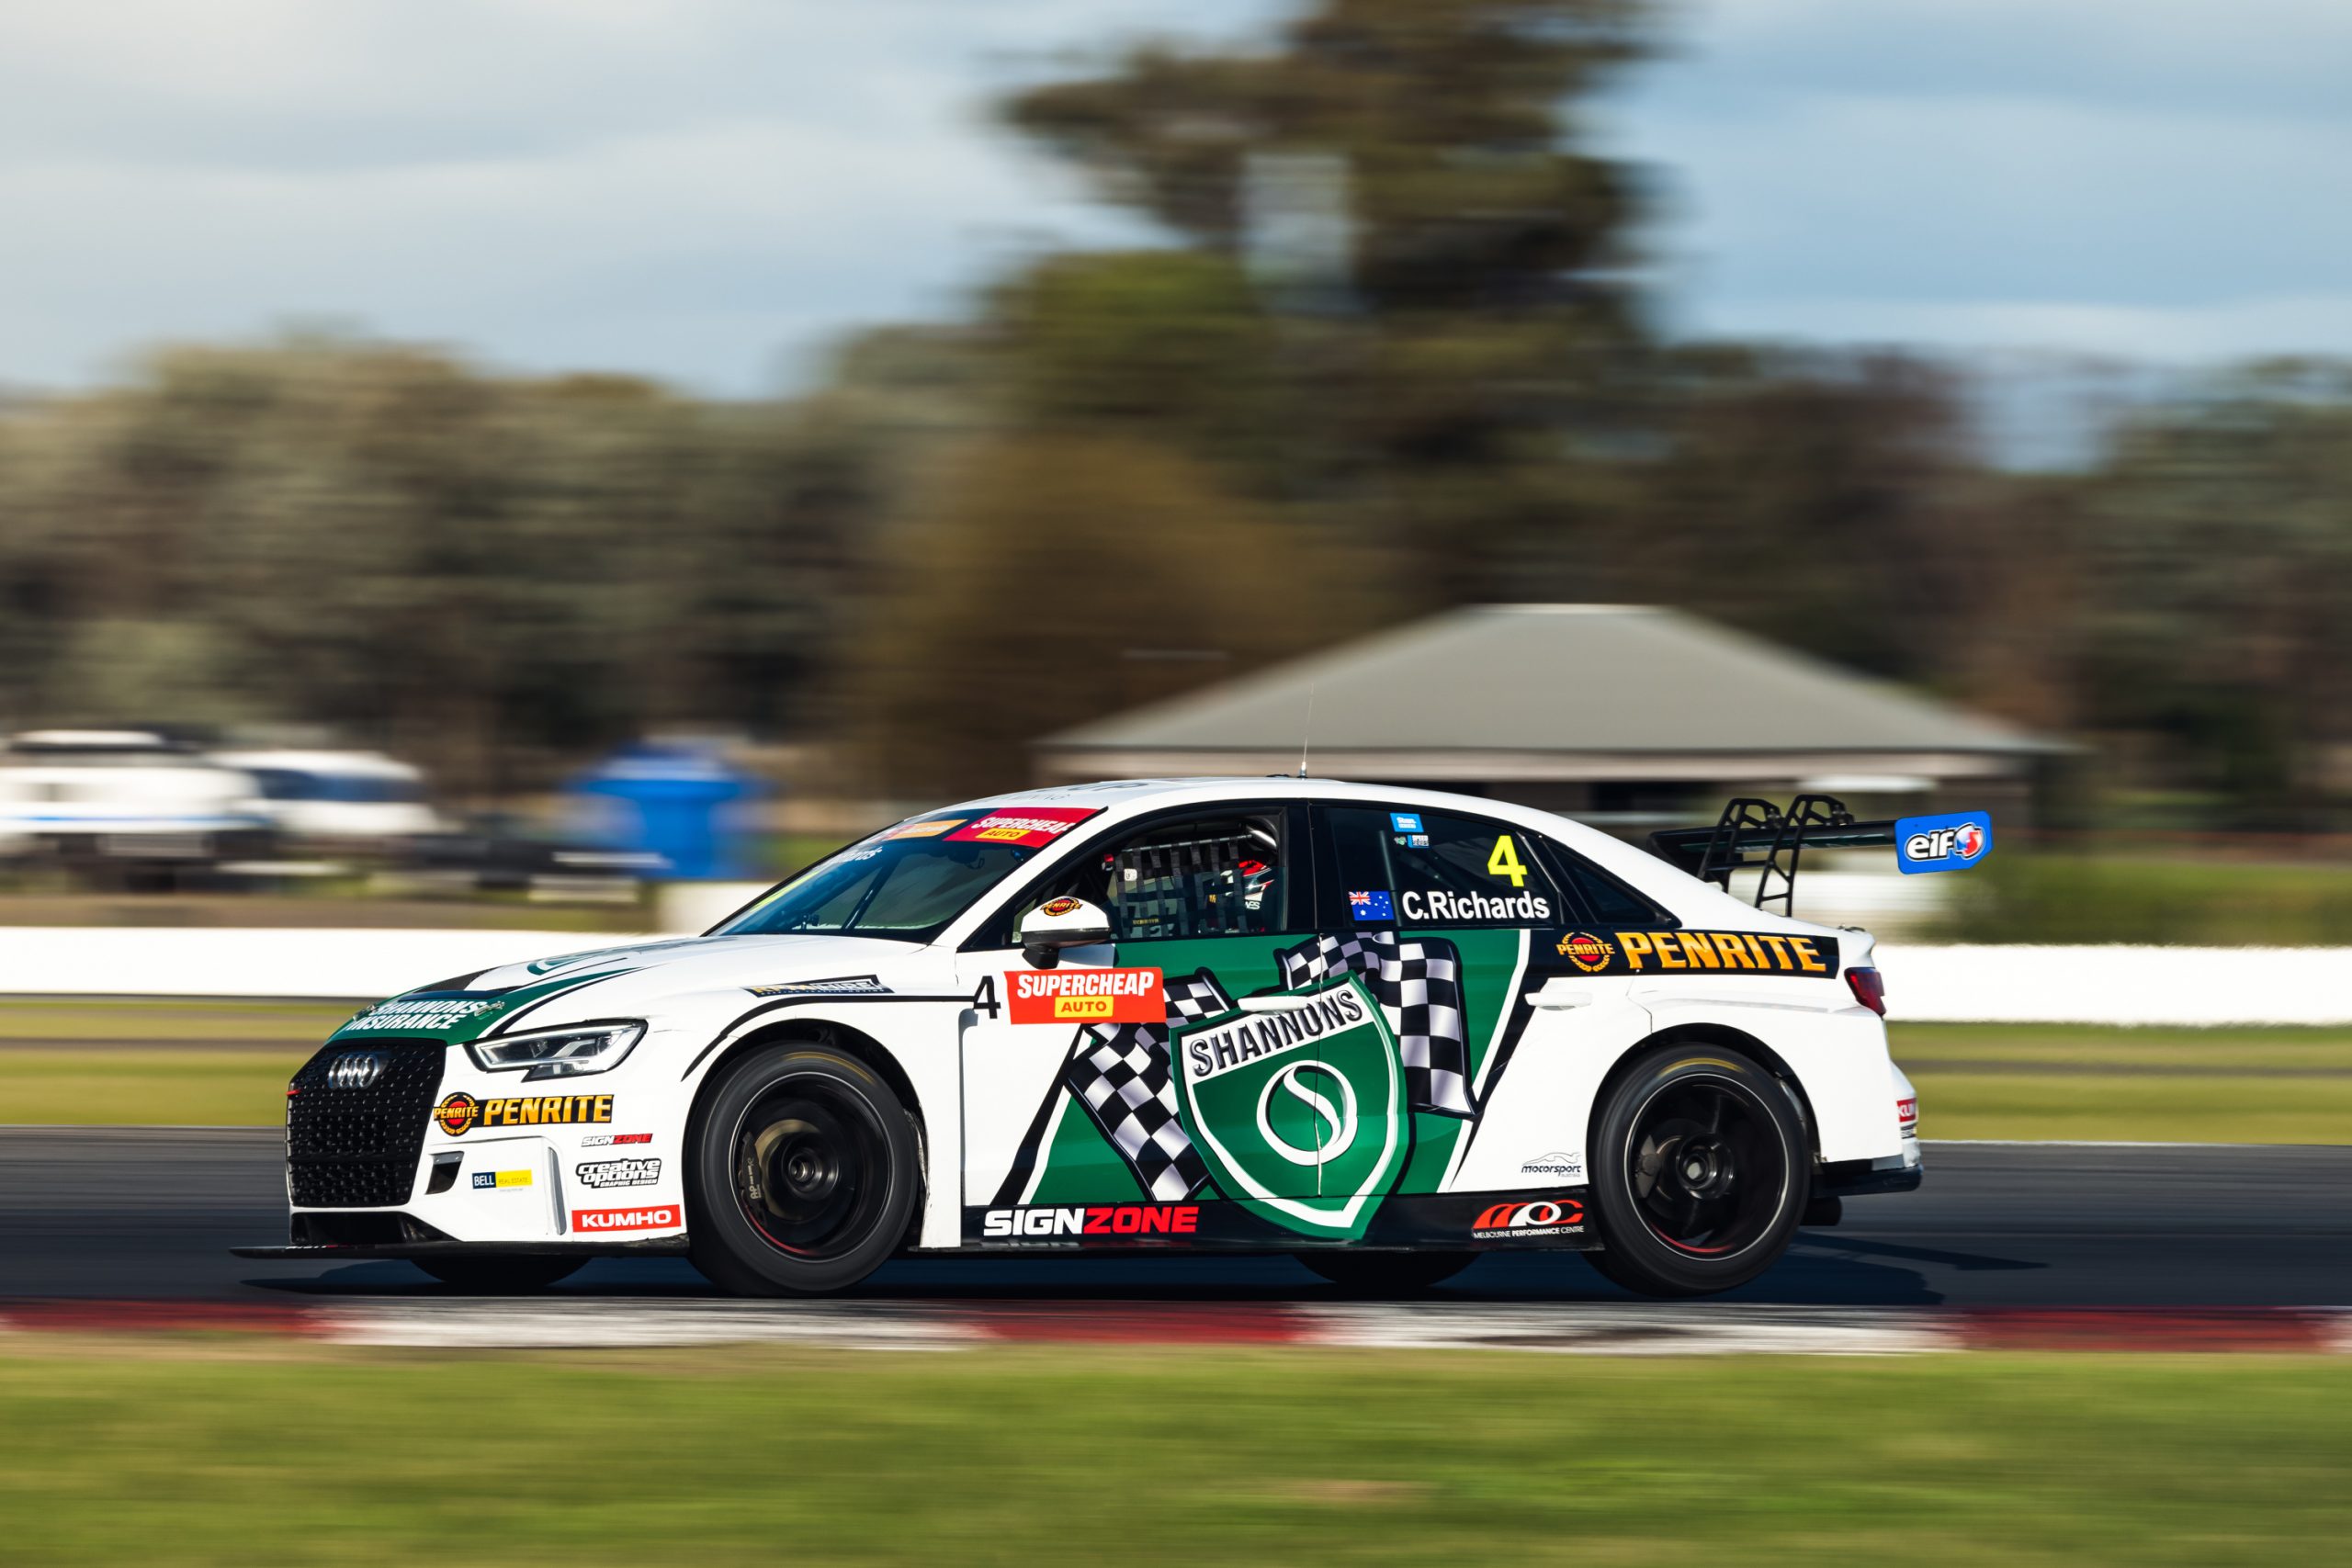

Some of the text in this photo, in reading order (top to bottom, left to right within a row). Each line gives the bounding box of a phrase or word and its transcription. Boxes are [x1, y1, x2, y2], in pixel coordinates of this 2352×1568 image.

[986, 829, 1020, 838] AUTO
[1905, 829, 1956, 861] elf
[1487, 835, 1528, 887] 4
[1402, 890, 1551, 919] C.Richards
[1556, 942, 1615, 956] PENRITE
[1615, 931, 1827, 972] PENRITE
[1017, 971, 1155, 998] SUPERCHEAP
[973, 975, 1001, 1020] 4
[1060, 1000, 1107, 1012] AUTO
[369, 1000, 487, 1016] SHANNONS
[345, 1013, 468, 1031] INSURANCE
[1189, 989, 1363, 1077] SHANNONS
[434, 1105, 480, 1119] PENRITE
[483, 1094, 613, 1126] PENRITE
[581, 1133, 653, 1147] SIGNZONE
[578, 1159, 661, 1175] creative
[1521, 1165, 1582, 1177] motorsport
[473, 1175, 495, 1187] BELL
[582, 1170, 659, 1187] options
[582, 1209, 672, 1228] KUMHO
[983, 1206, 1199, 1236] SIGNZONE
[1473, 1225, 1585, 1239] MELBOURNE PERFORMANCE CENTRE
